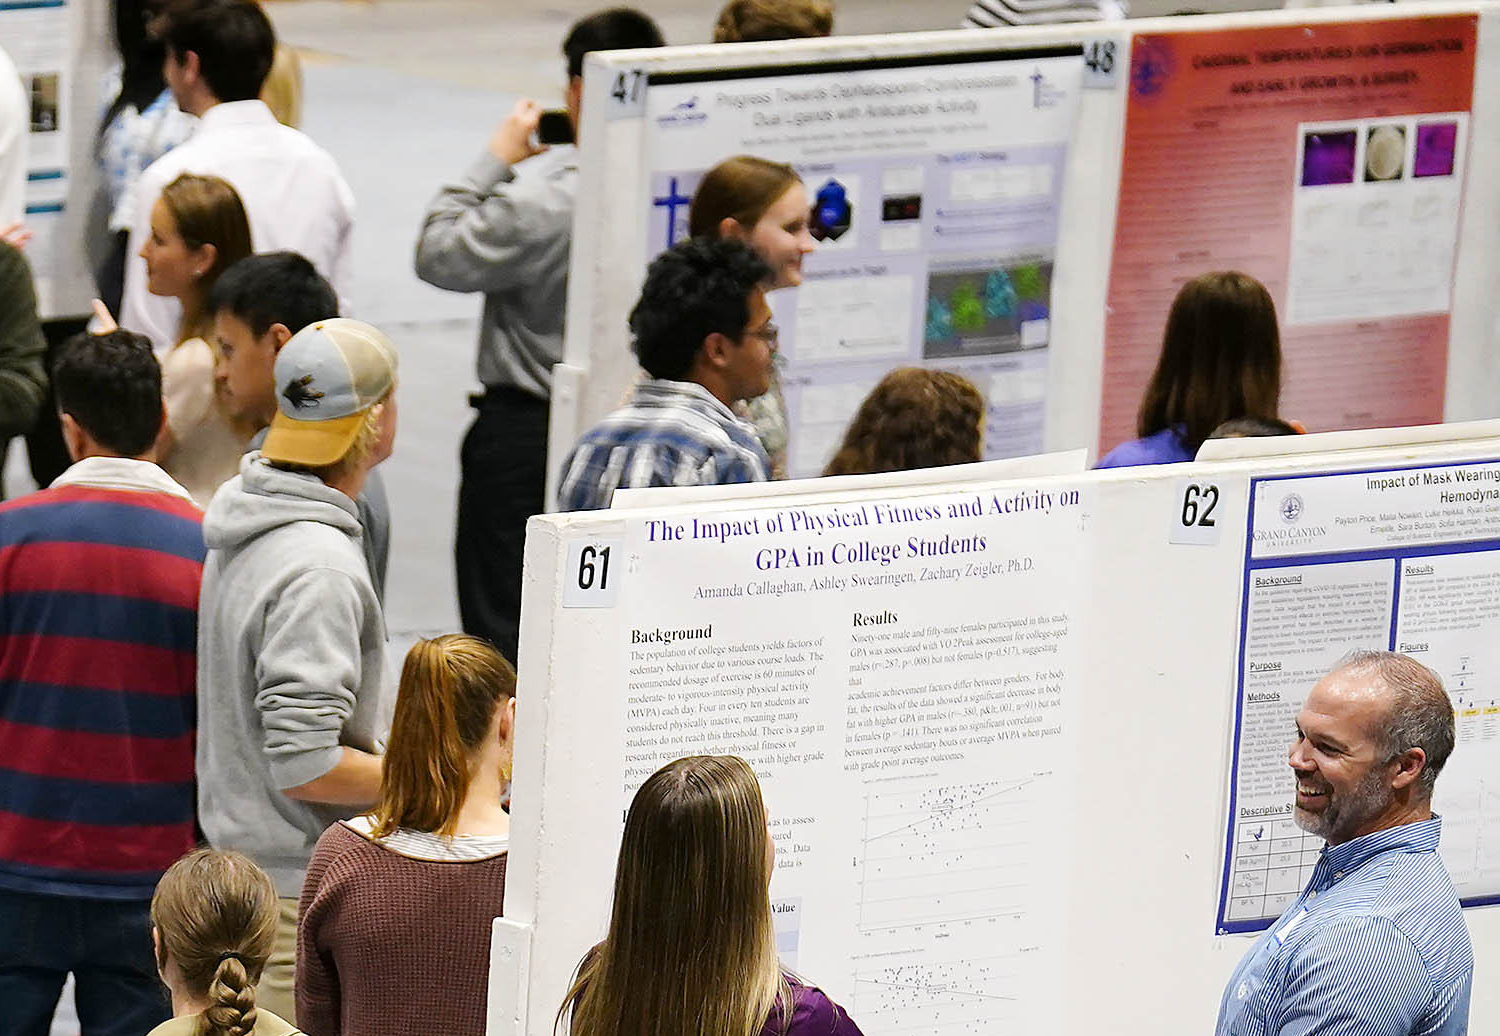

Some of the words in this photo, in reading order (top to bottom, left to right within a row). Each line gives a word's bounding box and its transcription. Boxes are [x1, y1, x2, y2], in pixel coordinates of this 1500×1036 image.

[1086, 41, 1114, 75] 48
[612, 70, 645, 103] 47
[1367, 476, 1405, 491] Impact
[1408, 472, 1420, 486] of
[1423, 471, 1452, 485] Mask
[1454, 468, 1500, 482] Wearing
[1182, 483, 1219, 527] 62
[645, 520, 684, 542] The
[692, 517, 760, 543] Impact
[766, 512, 783, 533] of
[790, 506, 869, 535] Physical
[874, 503, 941, 525] Fitness
[948, 496, 983, 518] and
[988, 488, 1055, 515] Activity
[1060, 488, 1080, 506] on
[1253, 529, 1286, 540] GRAND
[1288, 526, 1327, 538] CANYON
[756, 548, 801, 570] GPA
[807, 546, 824, 566] in
[831, 541, 901, 566] College
[907, 533, 987, 559] Students
[578, 546, 611, 590] 61
[694, 585, 743, 599] Amanda
[746, 580, 807, 597] Callaghan,
[809, 574, 847, 591] Ashley
[851, 570, 917, 590] Swearingen,
[920, 565, 963, 581] Zachary
[965, 560, 1005, 577] Zeigler,
[1007, 557, 1035, 573] Ph.D.
[1405, 564, 1434, 575] Results
[1255, 574, 1302, 586] Background
[853, 610, 898, 627] Results
[631, 625, 712, 645] Background
[1400, 641, 1429, 653] Figures
[1250, 660, 1282, 672] Purpose
[1248, 691, 1280, 702] Methods
[1240, 804, 1282, 817] Descriptive
